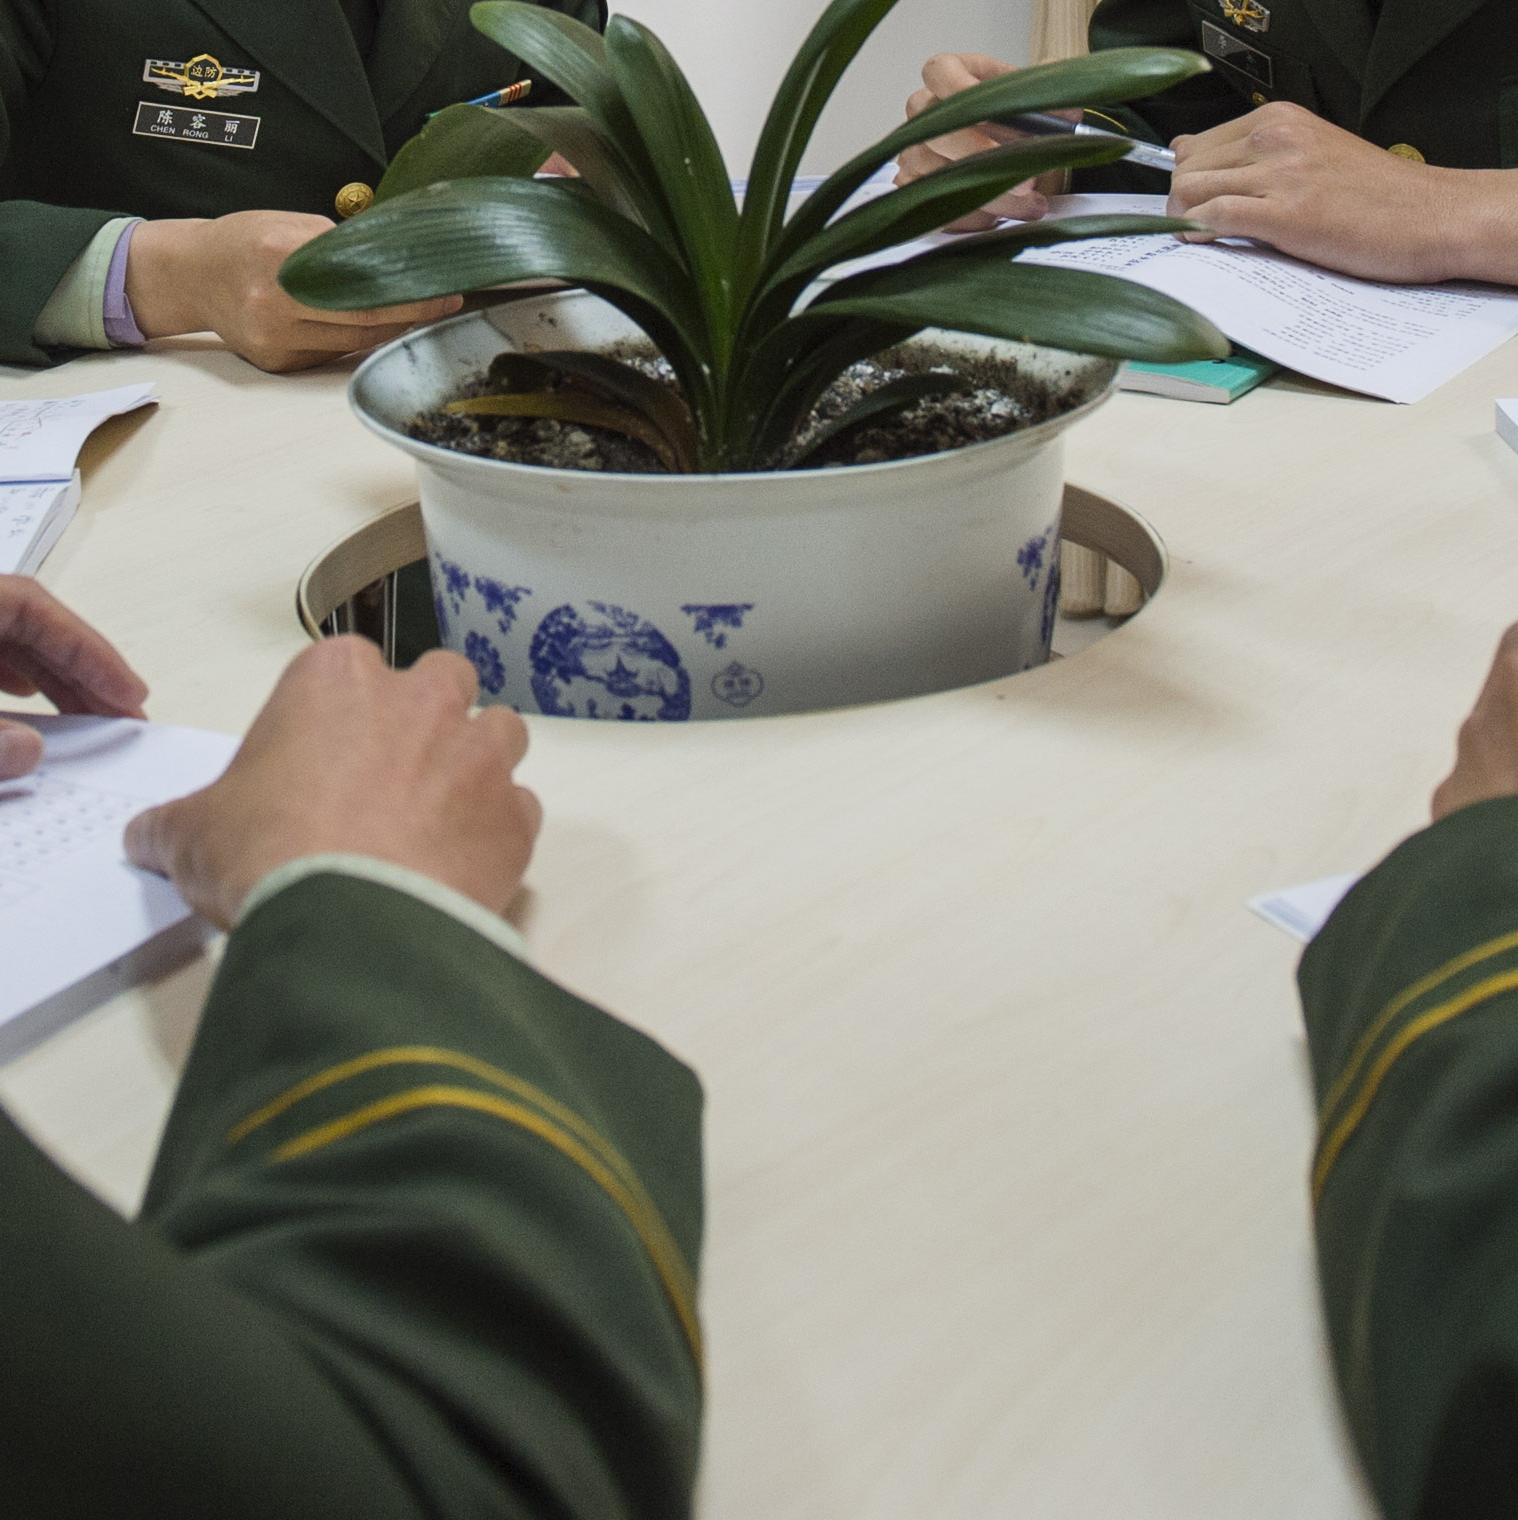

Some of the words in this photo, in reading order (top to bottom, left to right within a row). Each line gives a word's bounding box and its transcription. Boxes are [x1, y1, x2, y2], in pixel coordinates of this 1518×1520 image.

[191, 65, 217, 78] 边防
[157, 110, 240, 133] 陈容丽
[150, 125, 175, 135] CHEN
[183, 129, 209, 139] RONG
